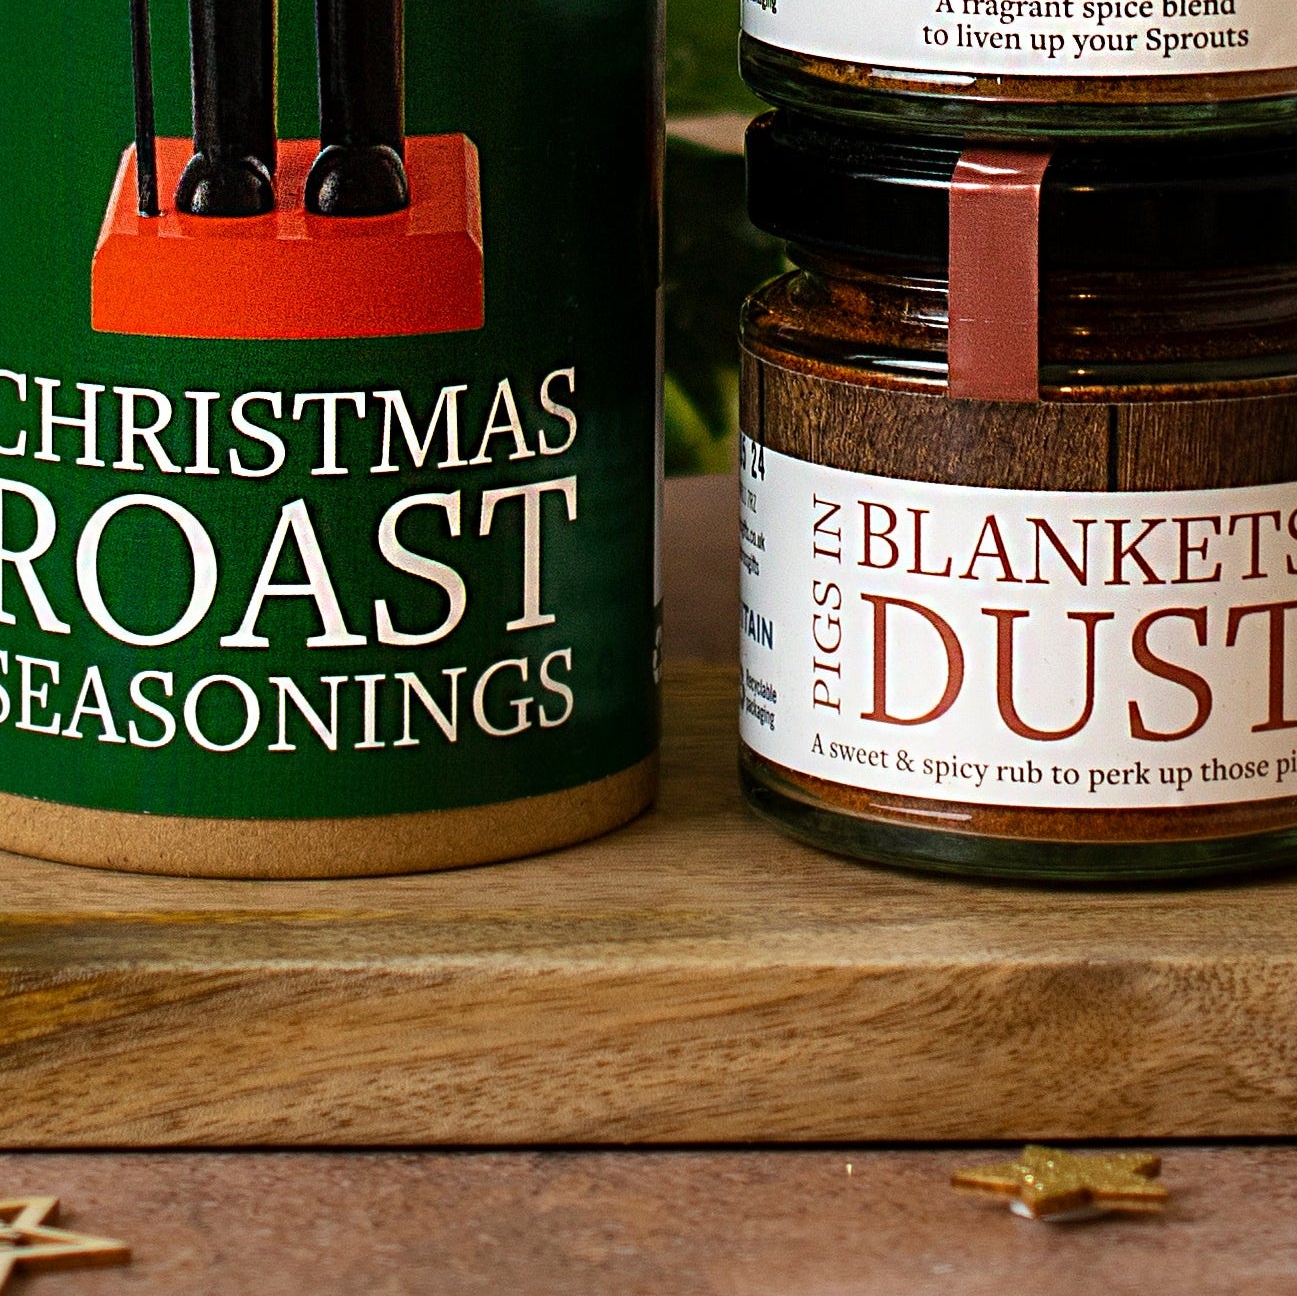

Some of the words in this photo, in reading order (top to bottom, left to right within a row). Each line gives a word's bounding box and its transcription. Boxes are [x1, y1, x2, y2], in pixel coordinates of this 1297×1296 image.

[923, 26, 948, 45] to
[957, 24, 1021, 49] liven
[1030, 29, 1065, 58] up
[1073, 34, 1137, 59] your
[1147, 28, 1248, 58] Sprouts
[812, 492, 842, 565] IN
[812, 580, 842, 716] PIGS
[812, 733, 824, 755] A
[828, 741, 889, 770] sweet
[896, 750, 914, 772] &
[923, 754, 988, 786] spicy
[998, 761, 1042, 783] rub
[1052, 767, 1079, 784] to
[1089, 762, 1150, 792] perk
[1159, 767, 1192, 791] up
[1201, 758, 1269, 782] those
